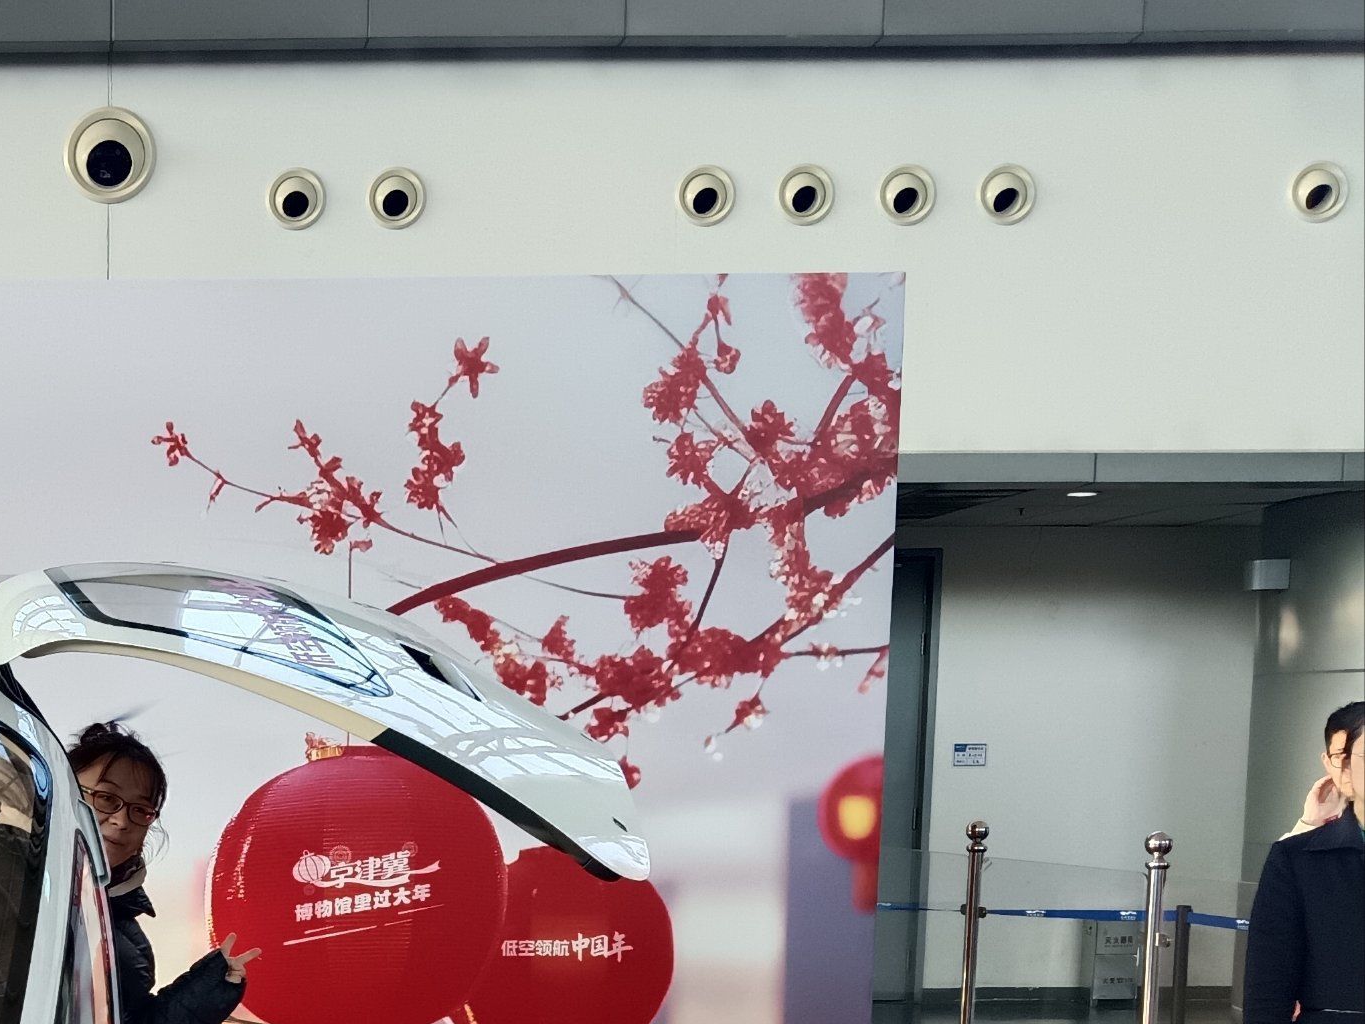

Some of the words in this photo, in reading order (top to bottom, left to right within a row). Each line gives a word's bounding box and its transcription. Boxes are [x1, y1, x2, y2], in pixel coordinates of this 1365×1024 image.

[294, 883, 432, 923] 博物馆里过大年
